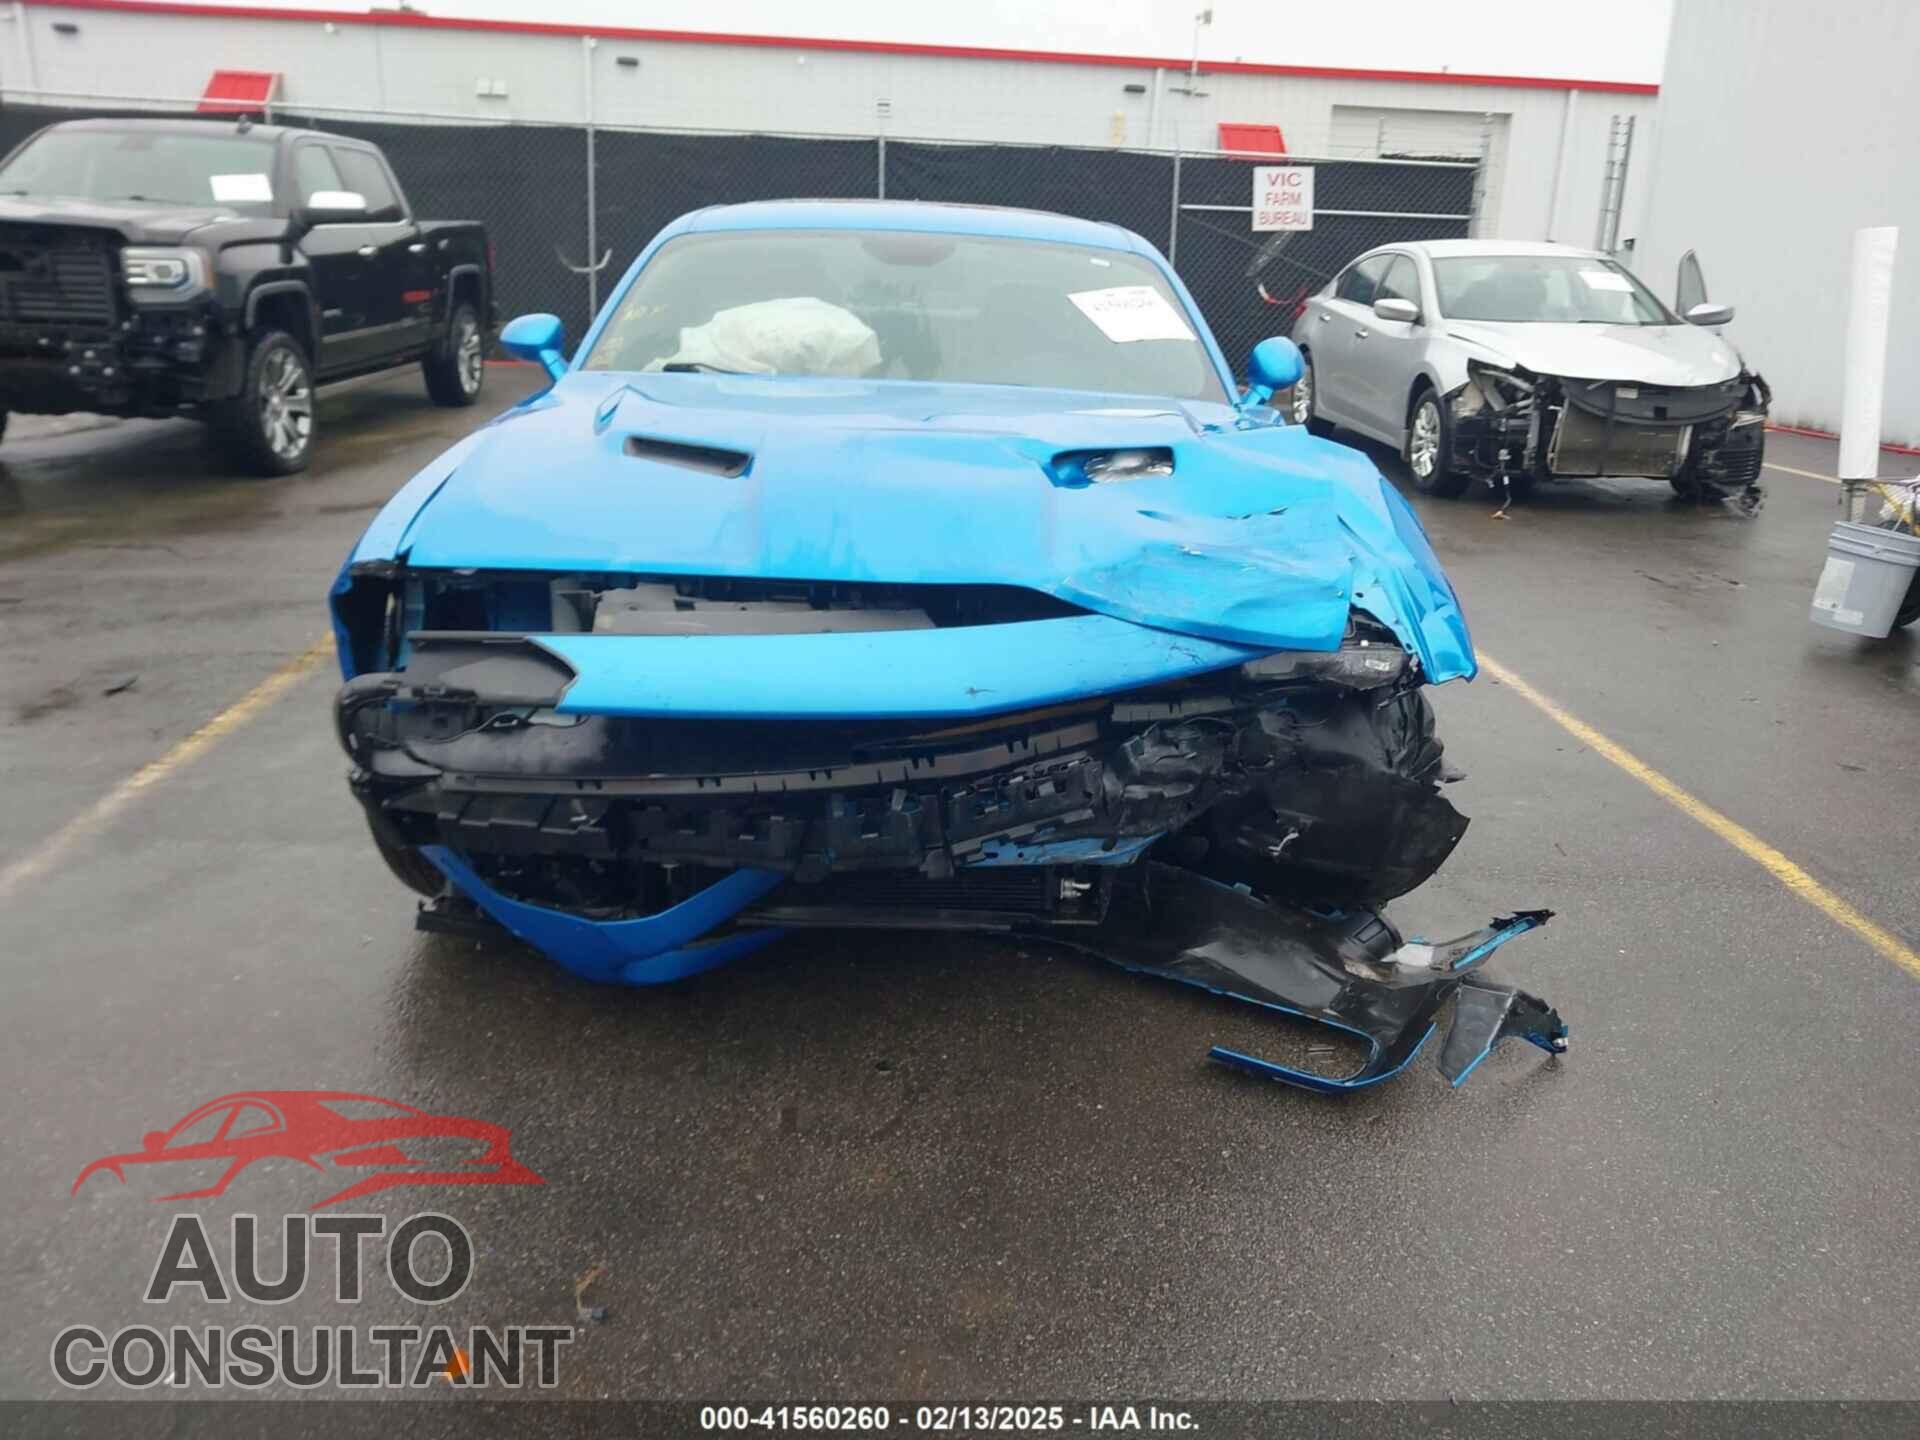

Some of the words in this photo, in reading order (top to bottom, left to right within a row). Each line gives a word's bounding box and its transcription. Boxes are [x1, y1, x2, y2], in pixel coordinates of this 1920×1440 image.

[1266, 172, 1302, 187] VIC
[1265, 192, 1302, 206] FARM
[1258, 211, 1308, 225] BUREAU
